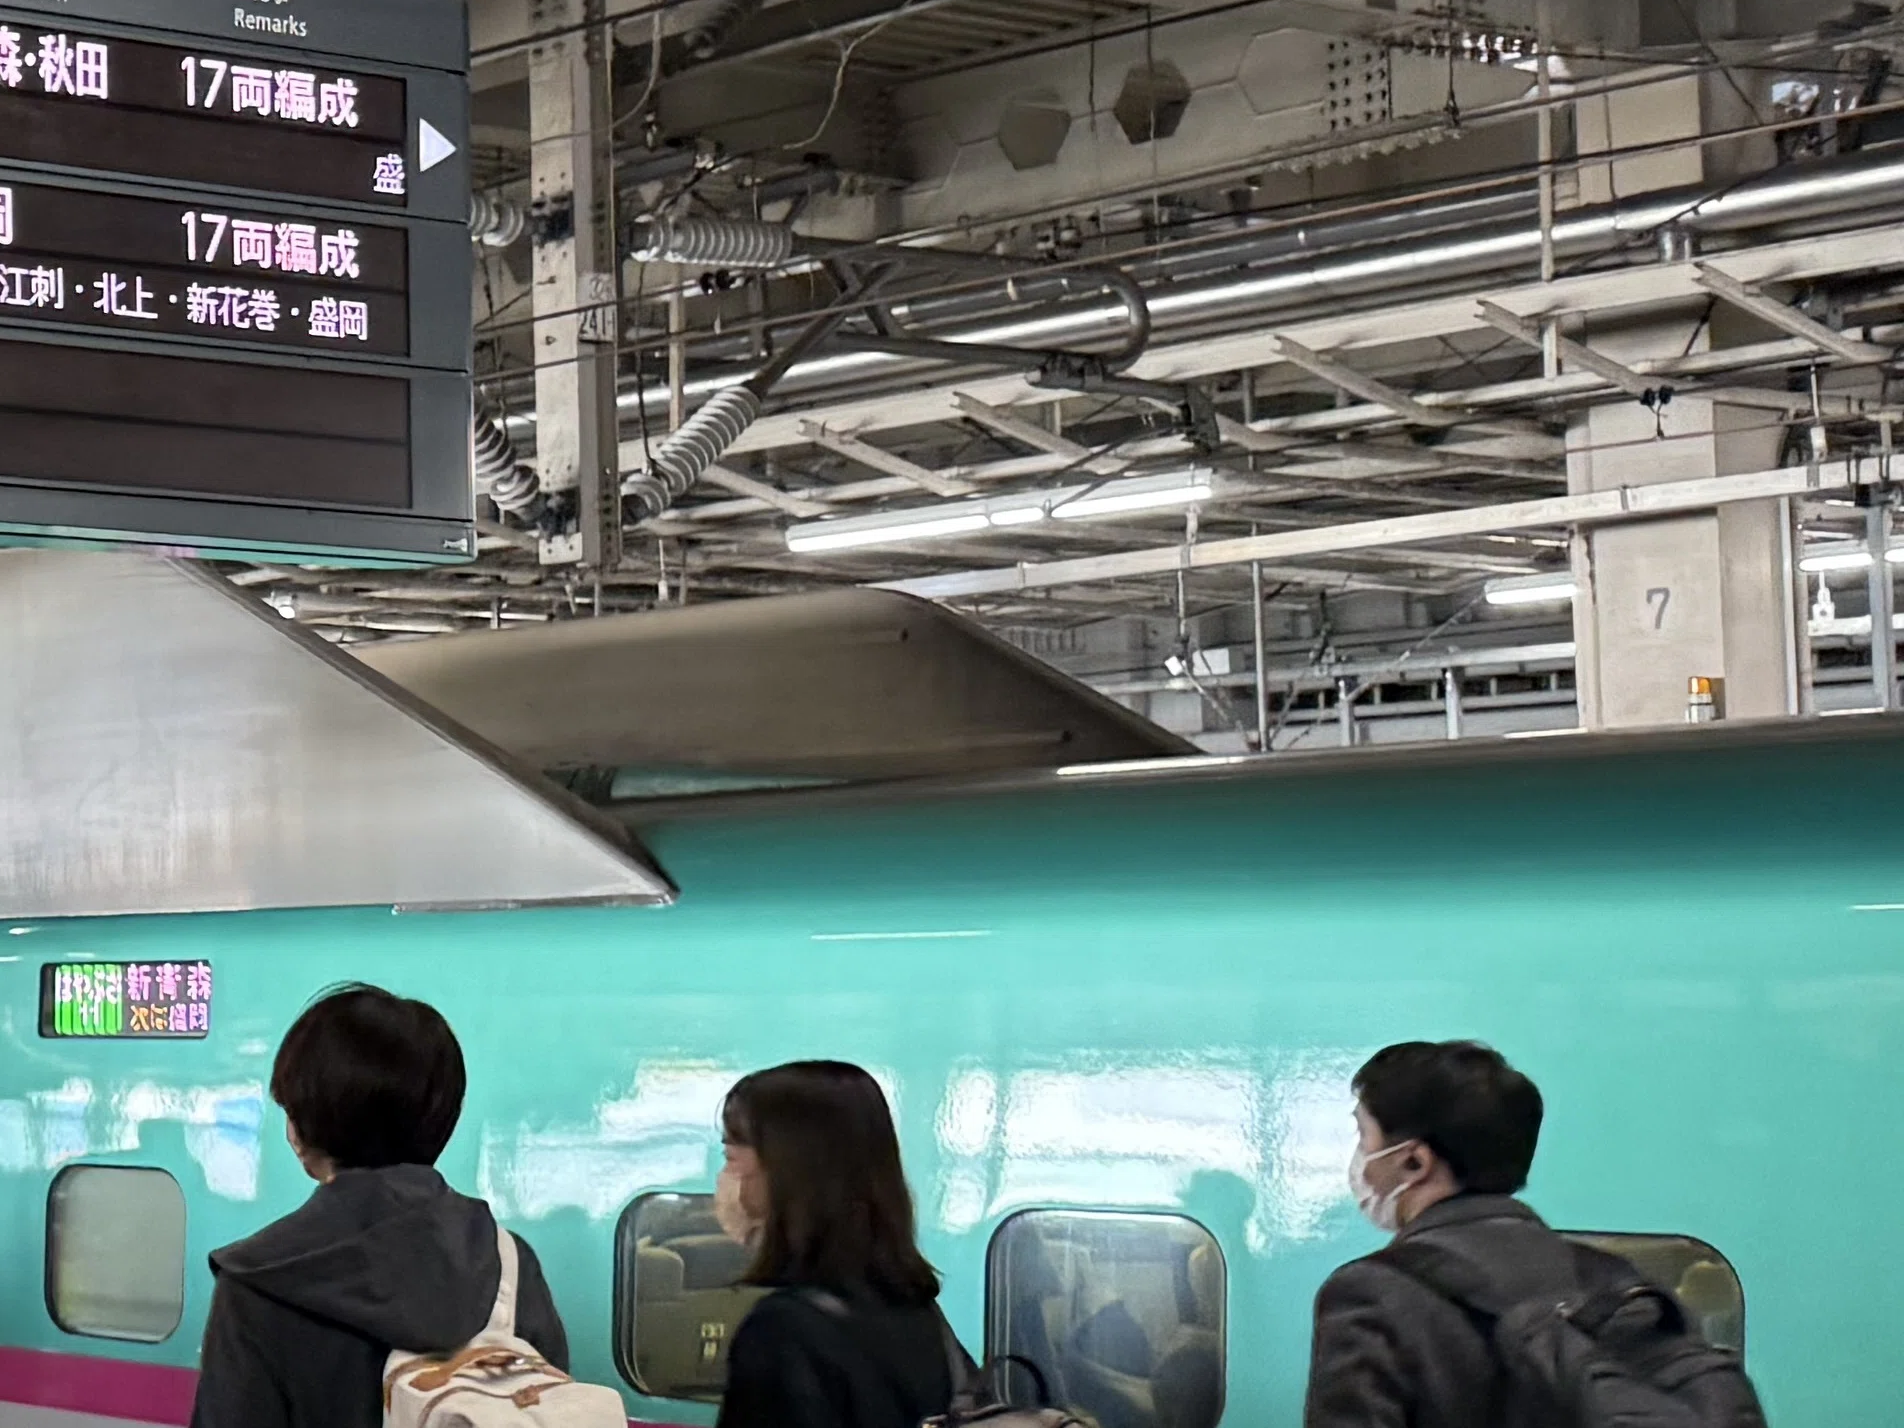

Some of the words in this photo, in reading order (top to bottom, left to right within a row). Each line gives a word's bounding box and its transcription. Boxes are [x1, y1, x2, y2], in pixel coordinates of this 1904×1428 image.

[233, 7, 308, 38] Remarks
[180, 56, 360, 128] 17両編成
[373, 153, 405, 195] 盛
[181, 211, 361, 279] 17両編成
[1646, 587, 1670, 630] 7
